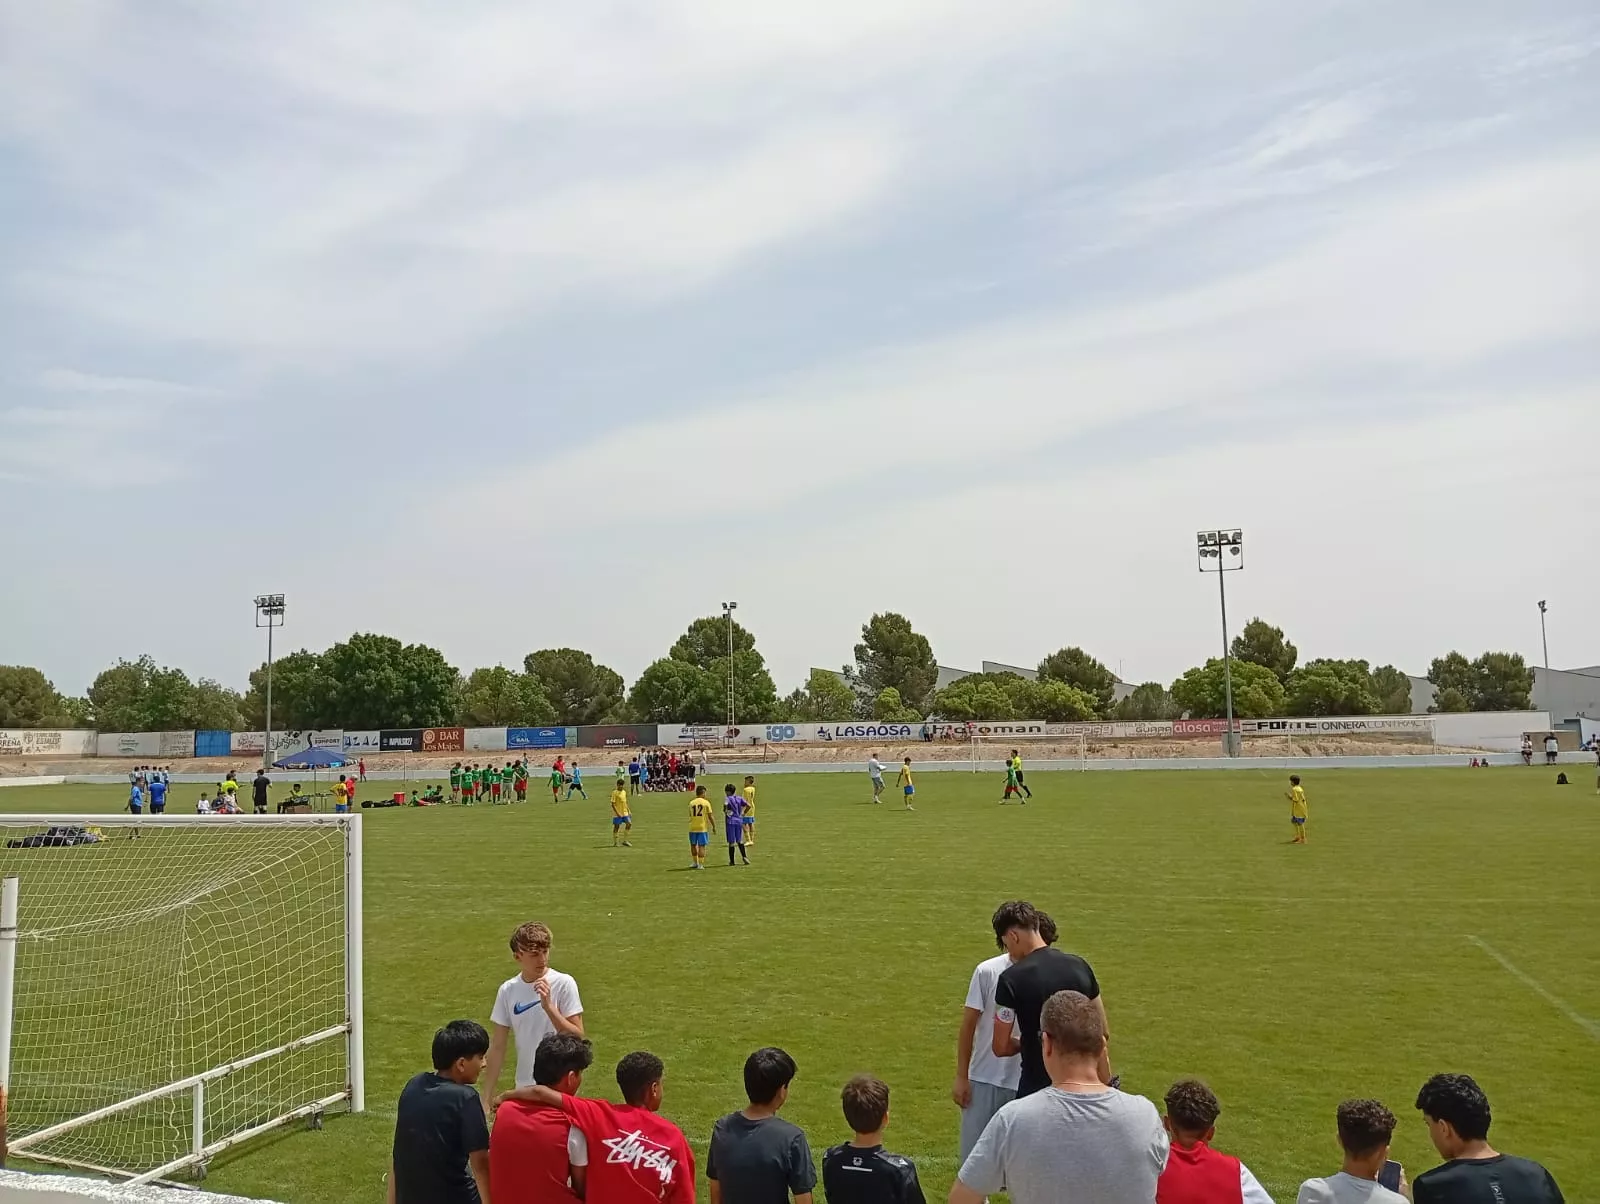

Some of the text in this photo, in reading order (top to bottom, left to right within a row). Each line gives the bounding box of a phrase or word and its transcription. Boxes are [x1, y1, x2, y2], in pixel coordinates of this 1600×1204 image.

[1174, 723, 1211, 733] alosa
[1321, 720, 1367, 730] ONNERA
[440, 731, 459, 740] BAR
[766, 725, 795, 742] igo
[836, 725, 911, 736] LASAOSA
[423, 742, 437, 751] Los
[692, 804, 704, 817] 12
